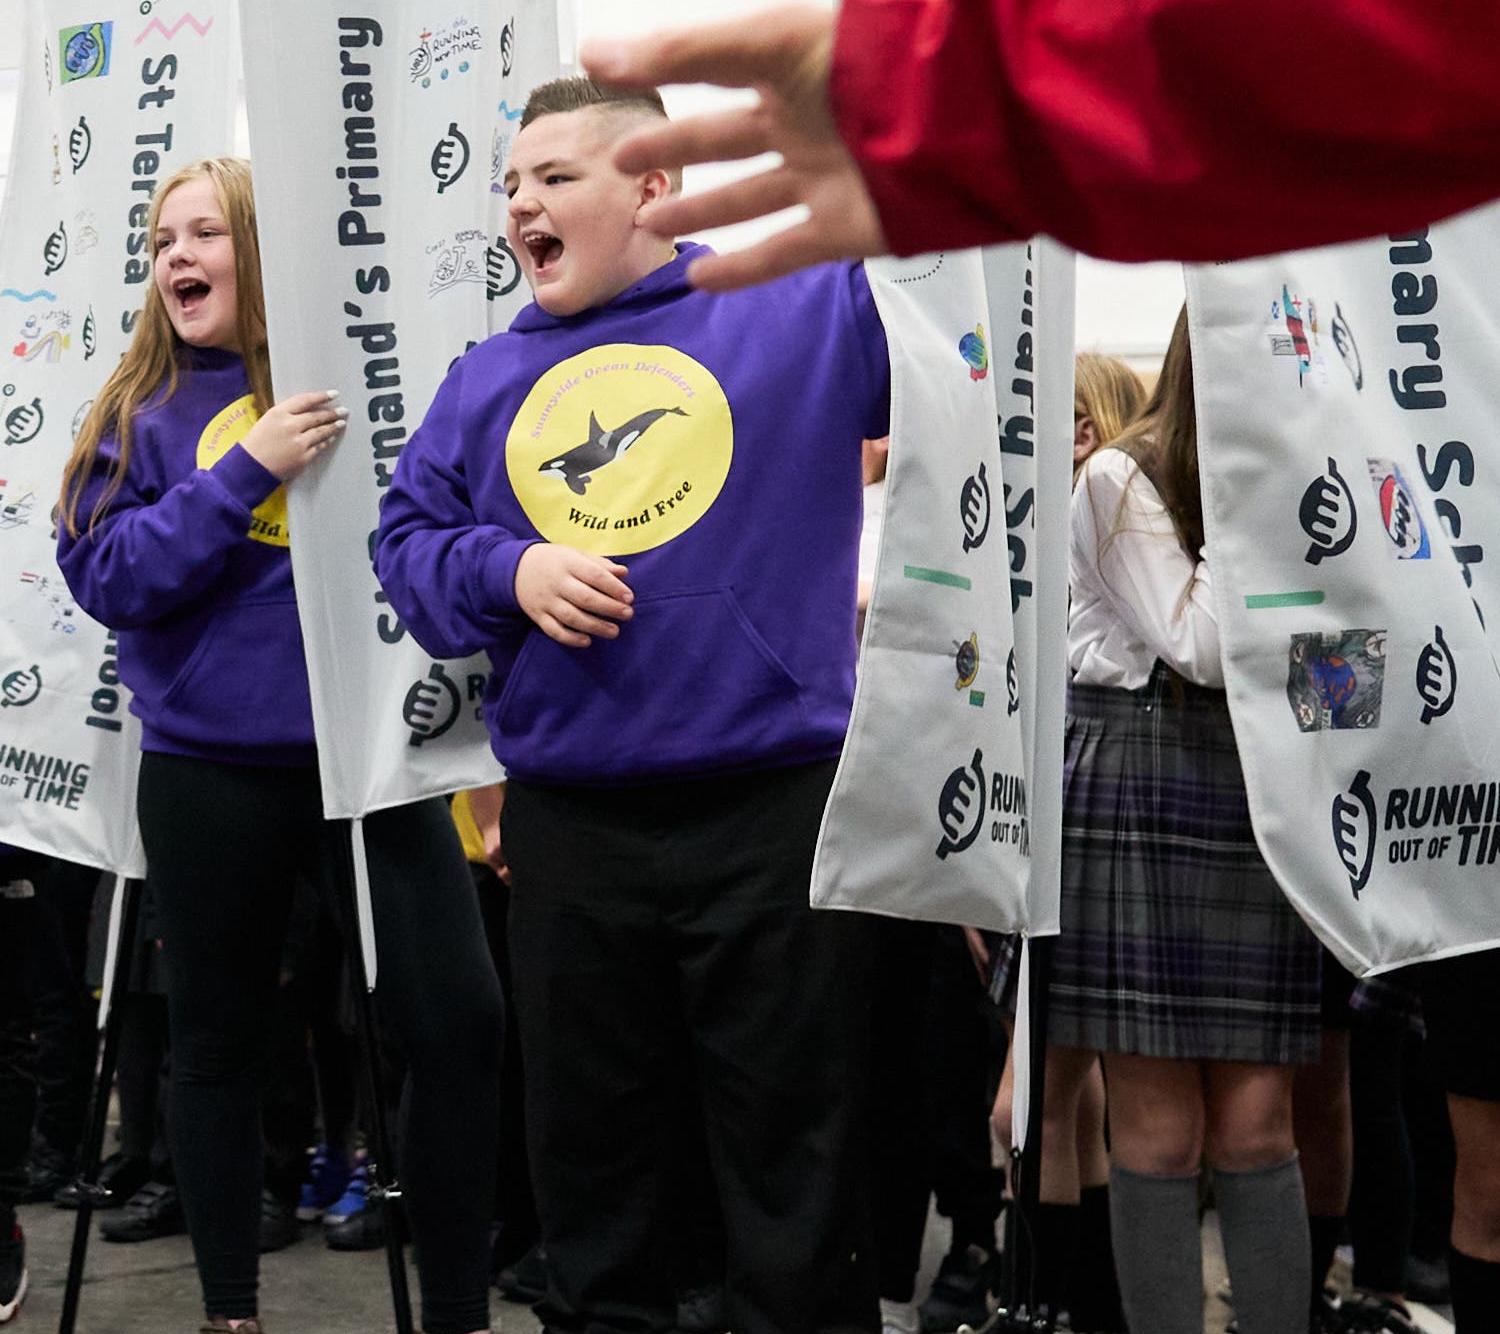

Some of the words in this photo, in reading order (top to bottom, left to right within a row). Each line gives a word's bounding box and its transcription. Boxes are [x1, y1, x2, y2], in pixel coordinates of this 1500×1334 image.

[138, 53, 178, 110] St
[335, 17, 385, 247] Primary
[531, 375, 581, 439] Sunnyside
[584, 361, 630, 380] Ocean
[633, 361, 697, 400] Defenders
[567, 507, 609, 531] Wild
[613, 509, 652, 530] and
[654, 479, 693, 517] Free
[0, 774, 19, 788] OF
[23, 775, 85, 812] TIME
[991, 820, 1010, 844] OUT
[1388, 838, 1424, 864] OUT
[1427, 836, 1451, 860] OF
